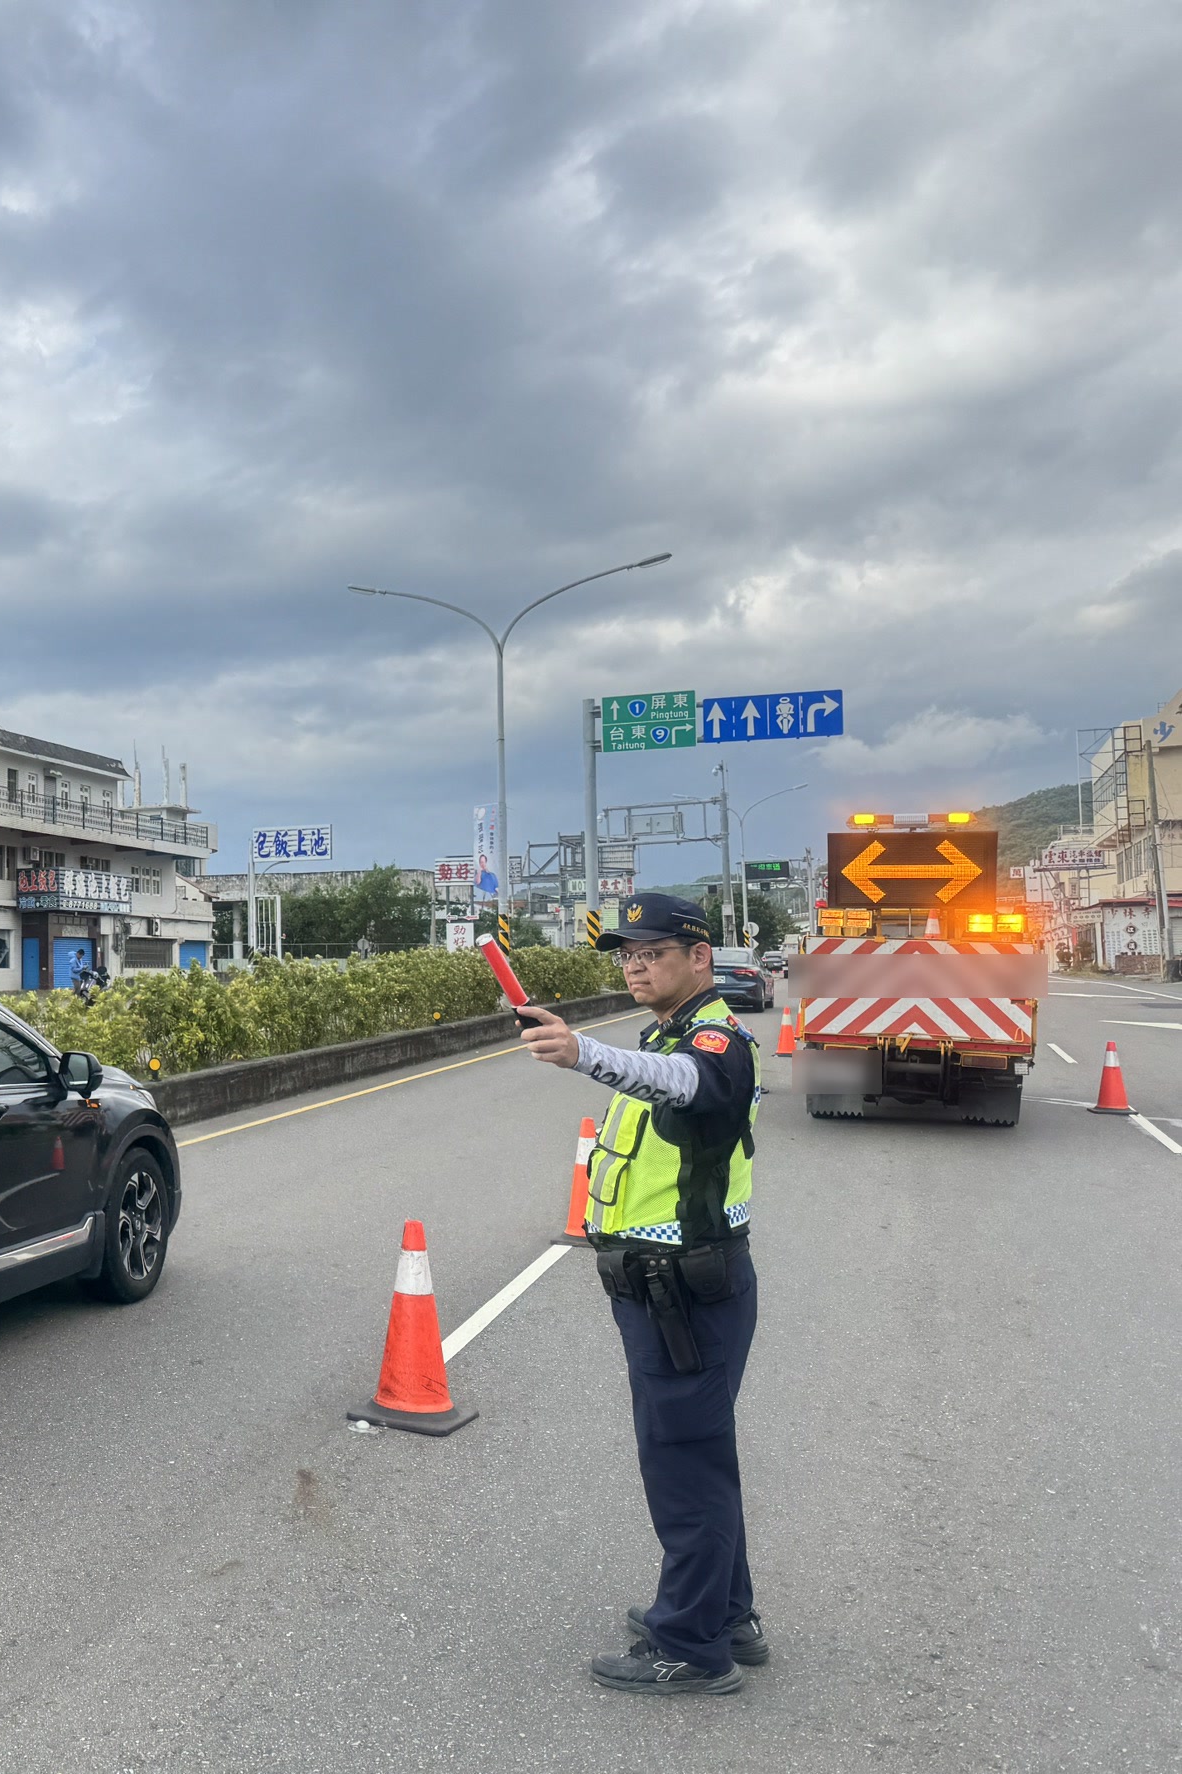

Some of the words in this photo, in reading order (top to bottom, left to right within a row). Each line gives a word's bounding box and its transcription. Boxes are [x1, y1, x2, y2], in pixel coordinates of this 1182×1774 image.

[651, 694, 688, 709] 屏東
[651, 711, 689, 720] Pingtung
[610, 725, 646, 740] 台東
[656, 729, 665, 739] 9
[611, 742, 646, 750] Taitung
[590, 1063, 668, 1105] POLICE
